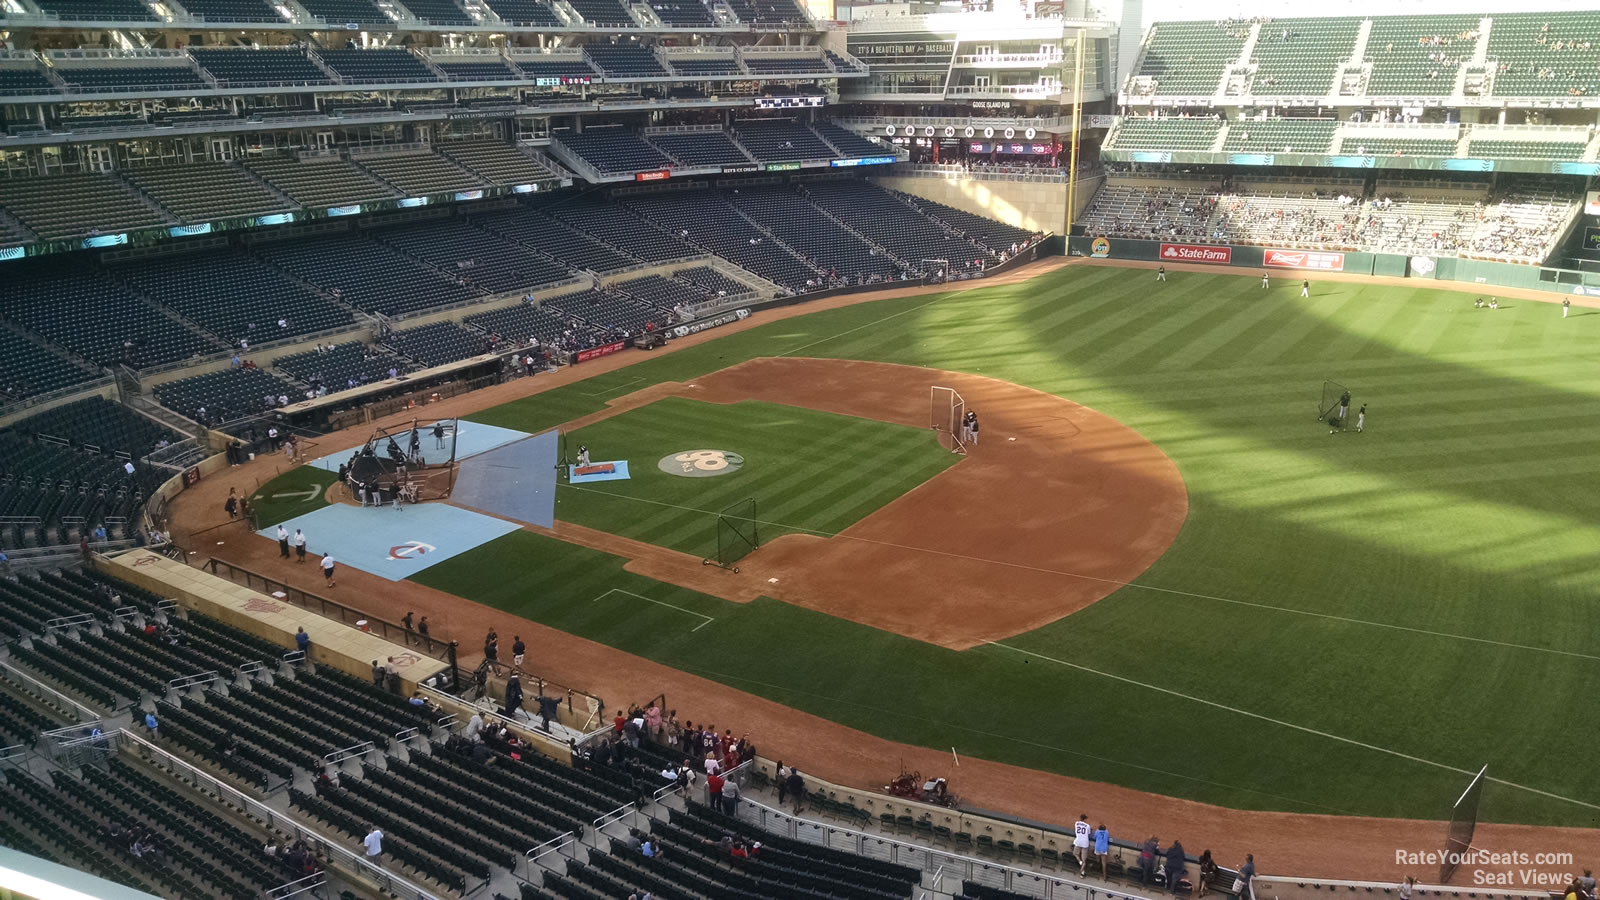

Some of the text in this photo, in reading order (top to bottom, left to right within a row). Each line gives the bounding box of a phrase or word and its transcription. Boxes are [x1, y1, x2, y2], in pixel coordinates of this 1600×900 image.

[858, 46, 869, 54] IT'S
[875, 45, 904, 54] BEAUTIFUL
[905, 45, 915, 53] DAY
[925, 44, 952, 52] BASEBALL
[703, 738, 714, 747] 84
[1076, 826, 1086, 835] 20
